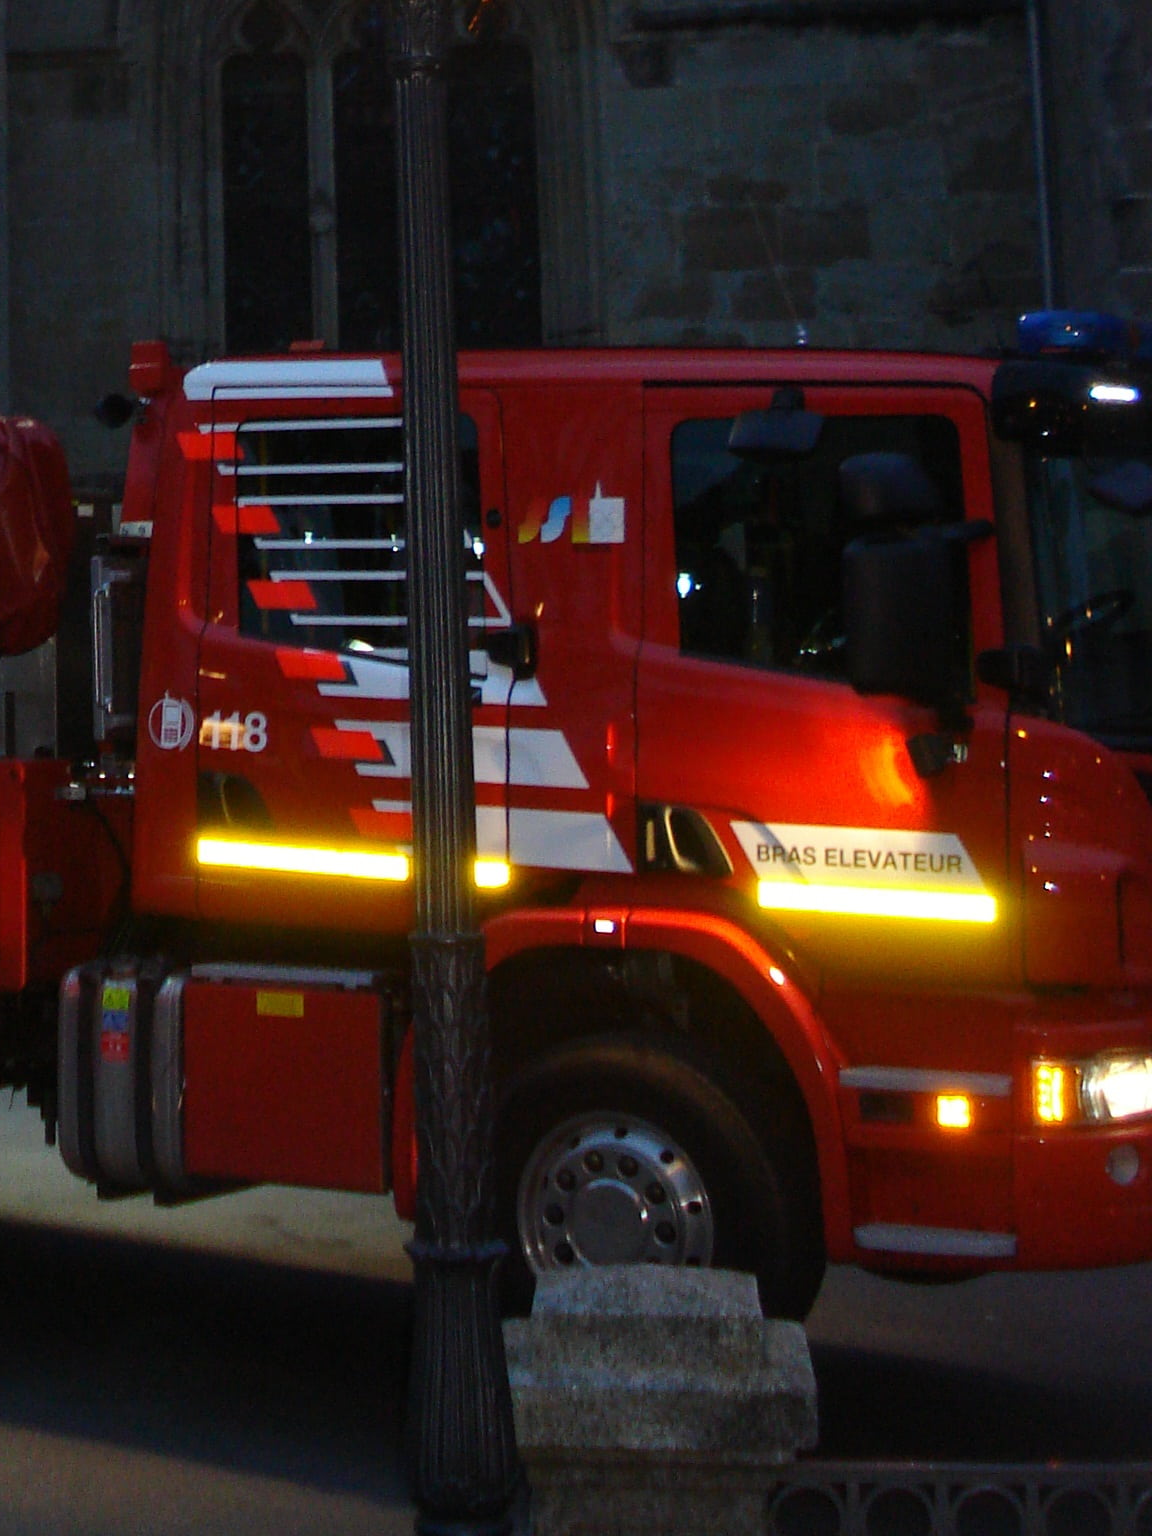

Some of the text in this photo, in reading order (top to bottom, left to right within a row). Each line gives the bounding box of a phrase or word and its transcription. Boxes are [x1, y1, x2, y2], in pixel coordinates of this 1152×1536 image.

[203, 710, 268, 752] 118
[756, 844, 962, 874] BRAS ELEVATEUR
